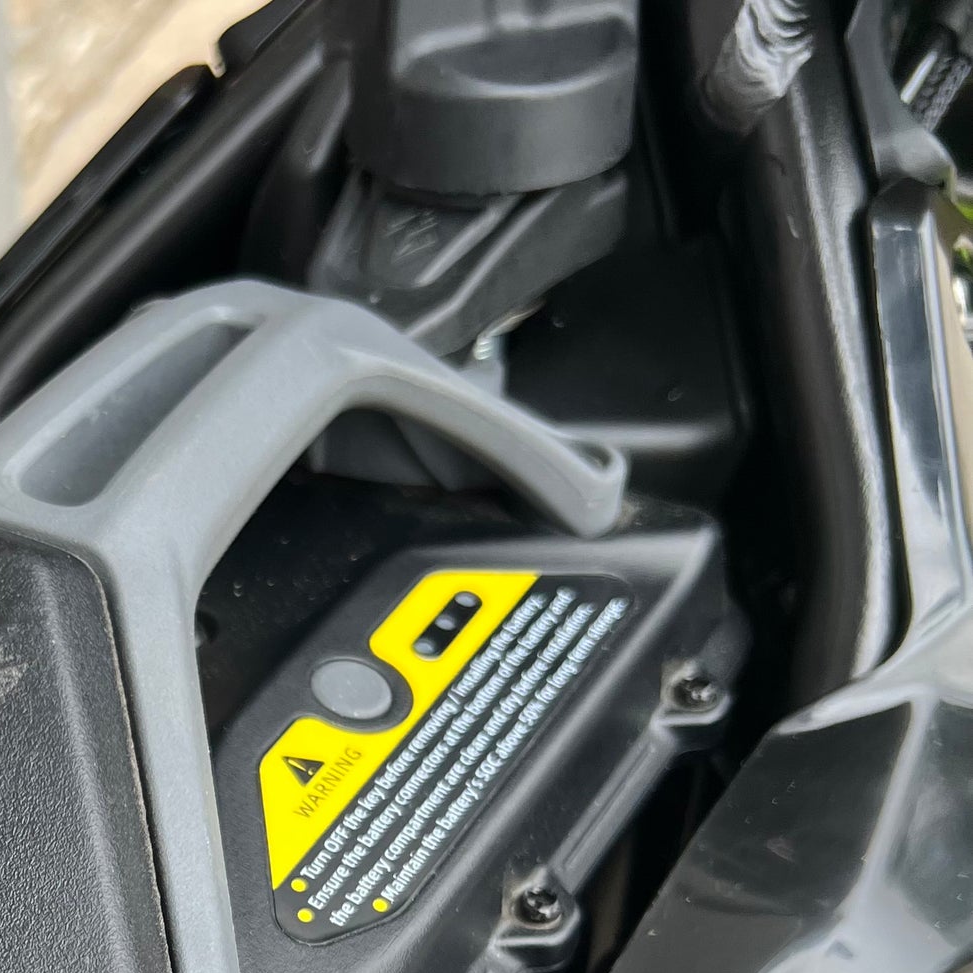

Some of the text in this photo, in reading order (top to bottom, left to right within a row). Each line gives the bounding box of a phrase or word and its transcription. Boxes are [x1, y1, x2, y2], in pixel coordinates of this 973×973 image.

[510, 656, 548, 699] before
[483, 707, 509, 736] and
[499, 689, 523, 714] dry
[299, 849, 332, 879] Turn
[323, 823, 349, 852] OFF
[342, 802, 370, 830] the
[357, 784, 387, 810] key
[374, 748, 415, 792] before
[407, 699, 458, 753] removing
[490, 628, 514, 654] the
[307, 589, 573, 910] Ensure the battery connectors at the bottom of the battery and
[380, 846, 431, 904] Maintain
[420, 825, 448, 852] the
[435, 773, 486, 832] battery's
[474, 752, 505, 782] SOC
[494, 720, 530, 759] above
[517, 699, 545, 726] 50%
[534, 680, 558, 705] for
[546, 634, 596, 689] long-term
[459, 730, 490, 765] clean
[292, 746, 364, 820] WARNING
[444, 760, 467, 785] are
[384, 779, 453, 860] compartment
[344, 855, 394, 907] battery
[328, 901, 358, 926] the
